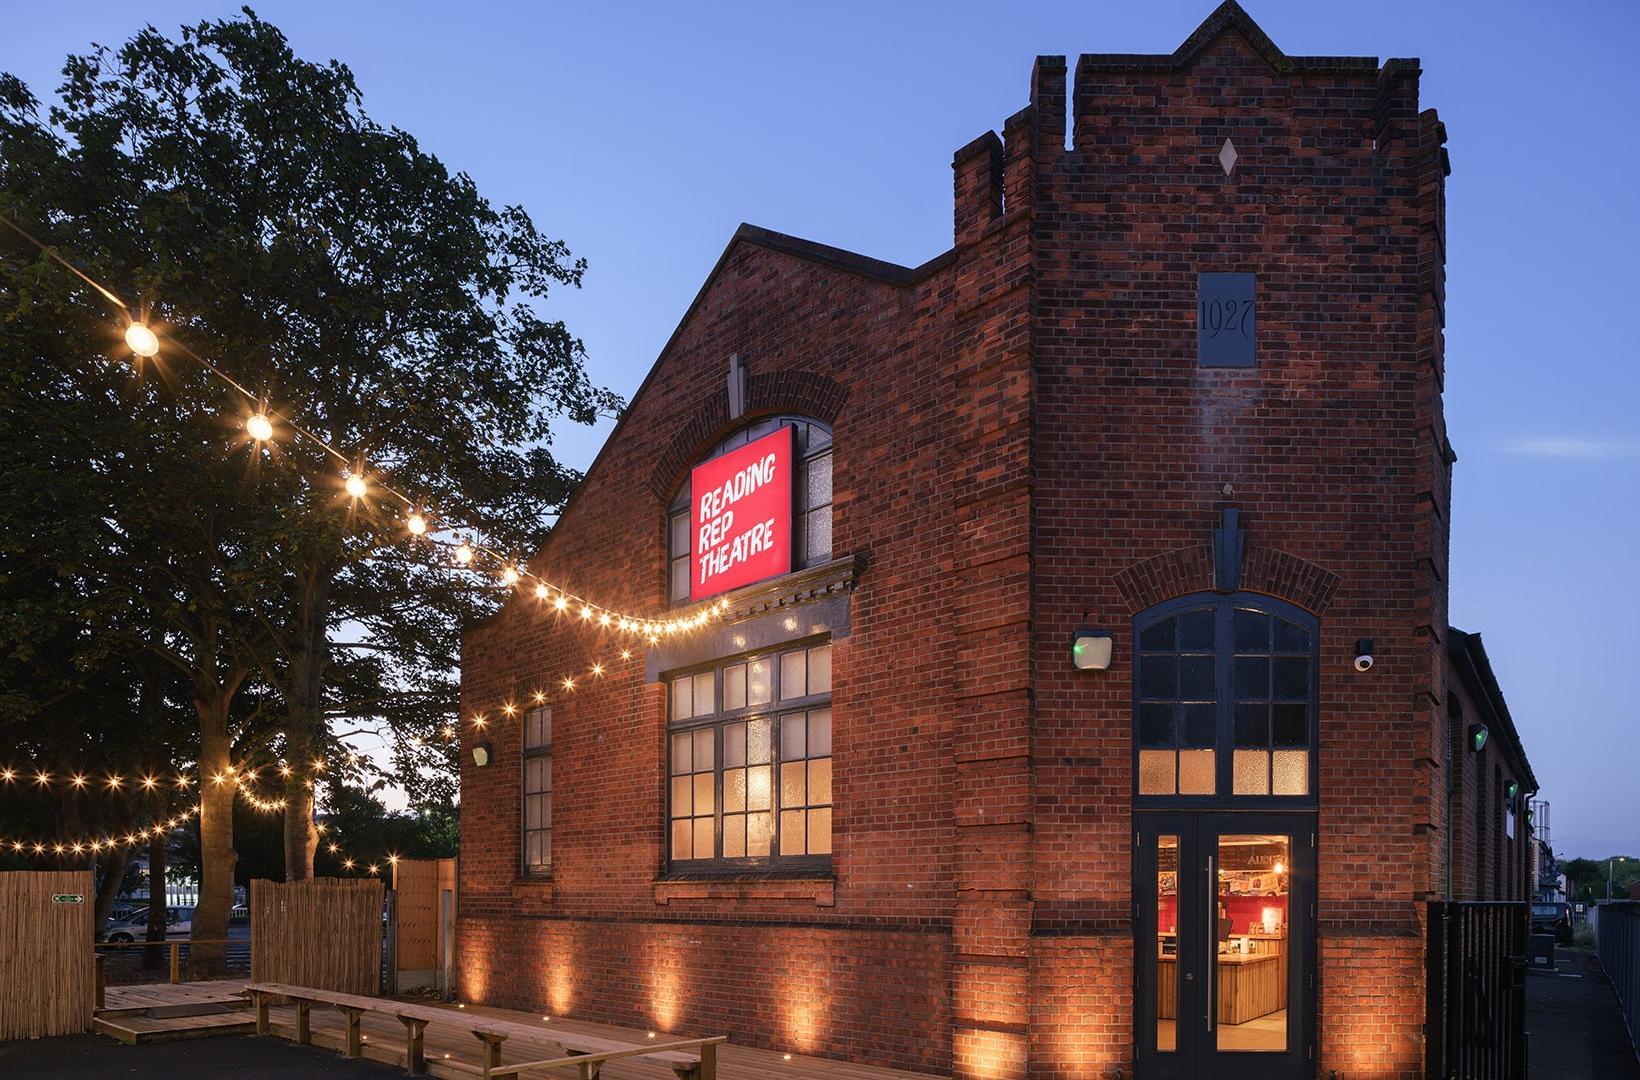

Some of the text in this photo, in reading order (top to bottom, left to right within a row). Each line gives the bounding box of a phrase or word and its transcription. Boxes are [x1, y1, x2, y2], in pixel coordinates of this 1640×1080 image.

[1201, 300, 1254, 339] 1927
[699, 511, 734, 555] REP
[699, 518, 775, 584] THEATRE
